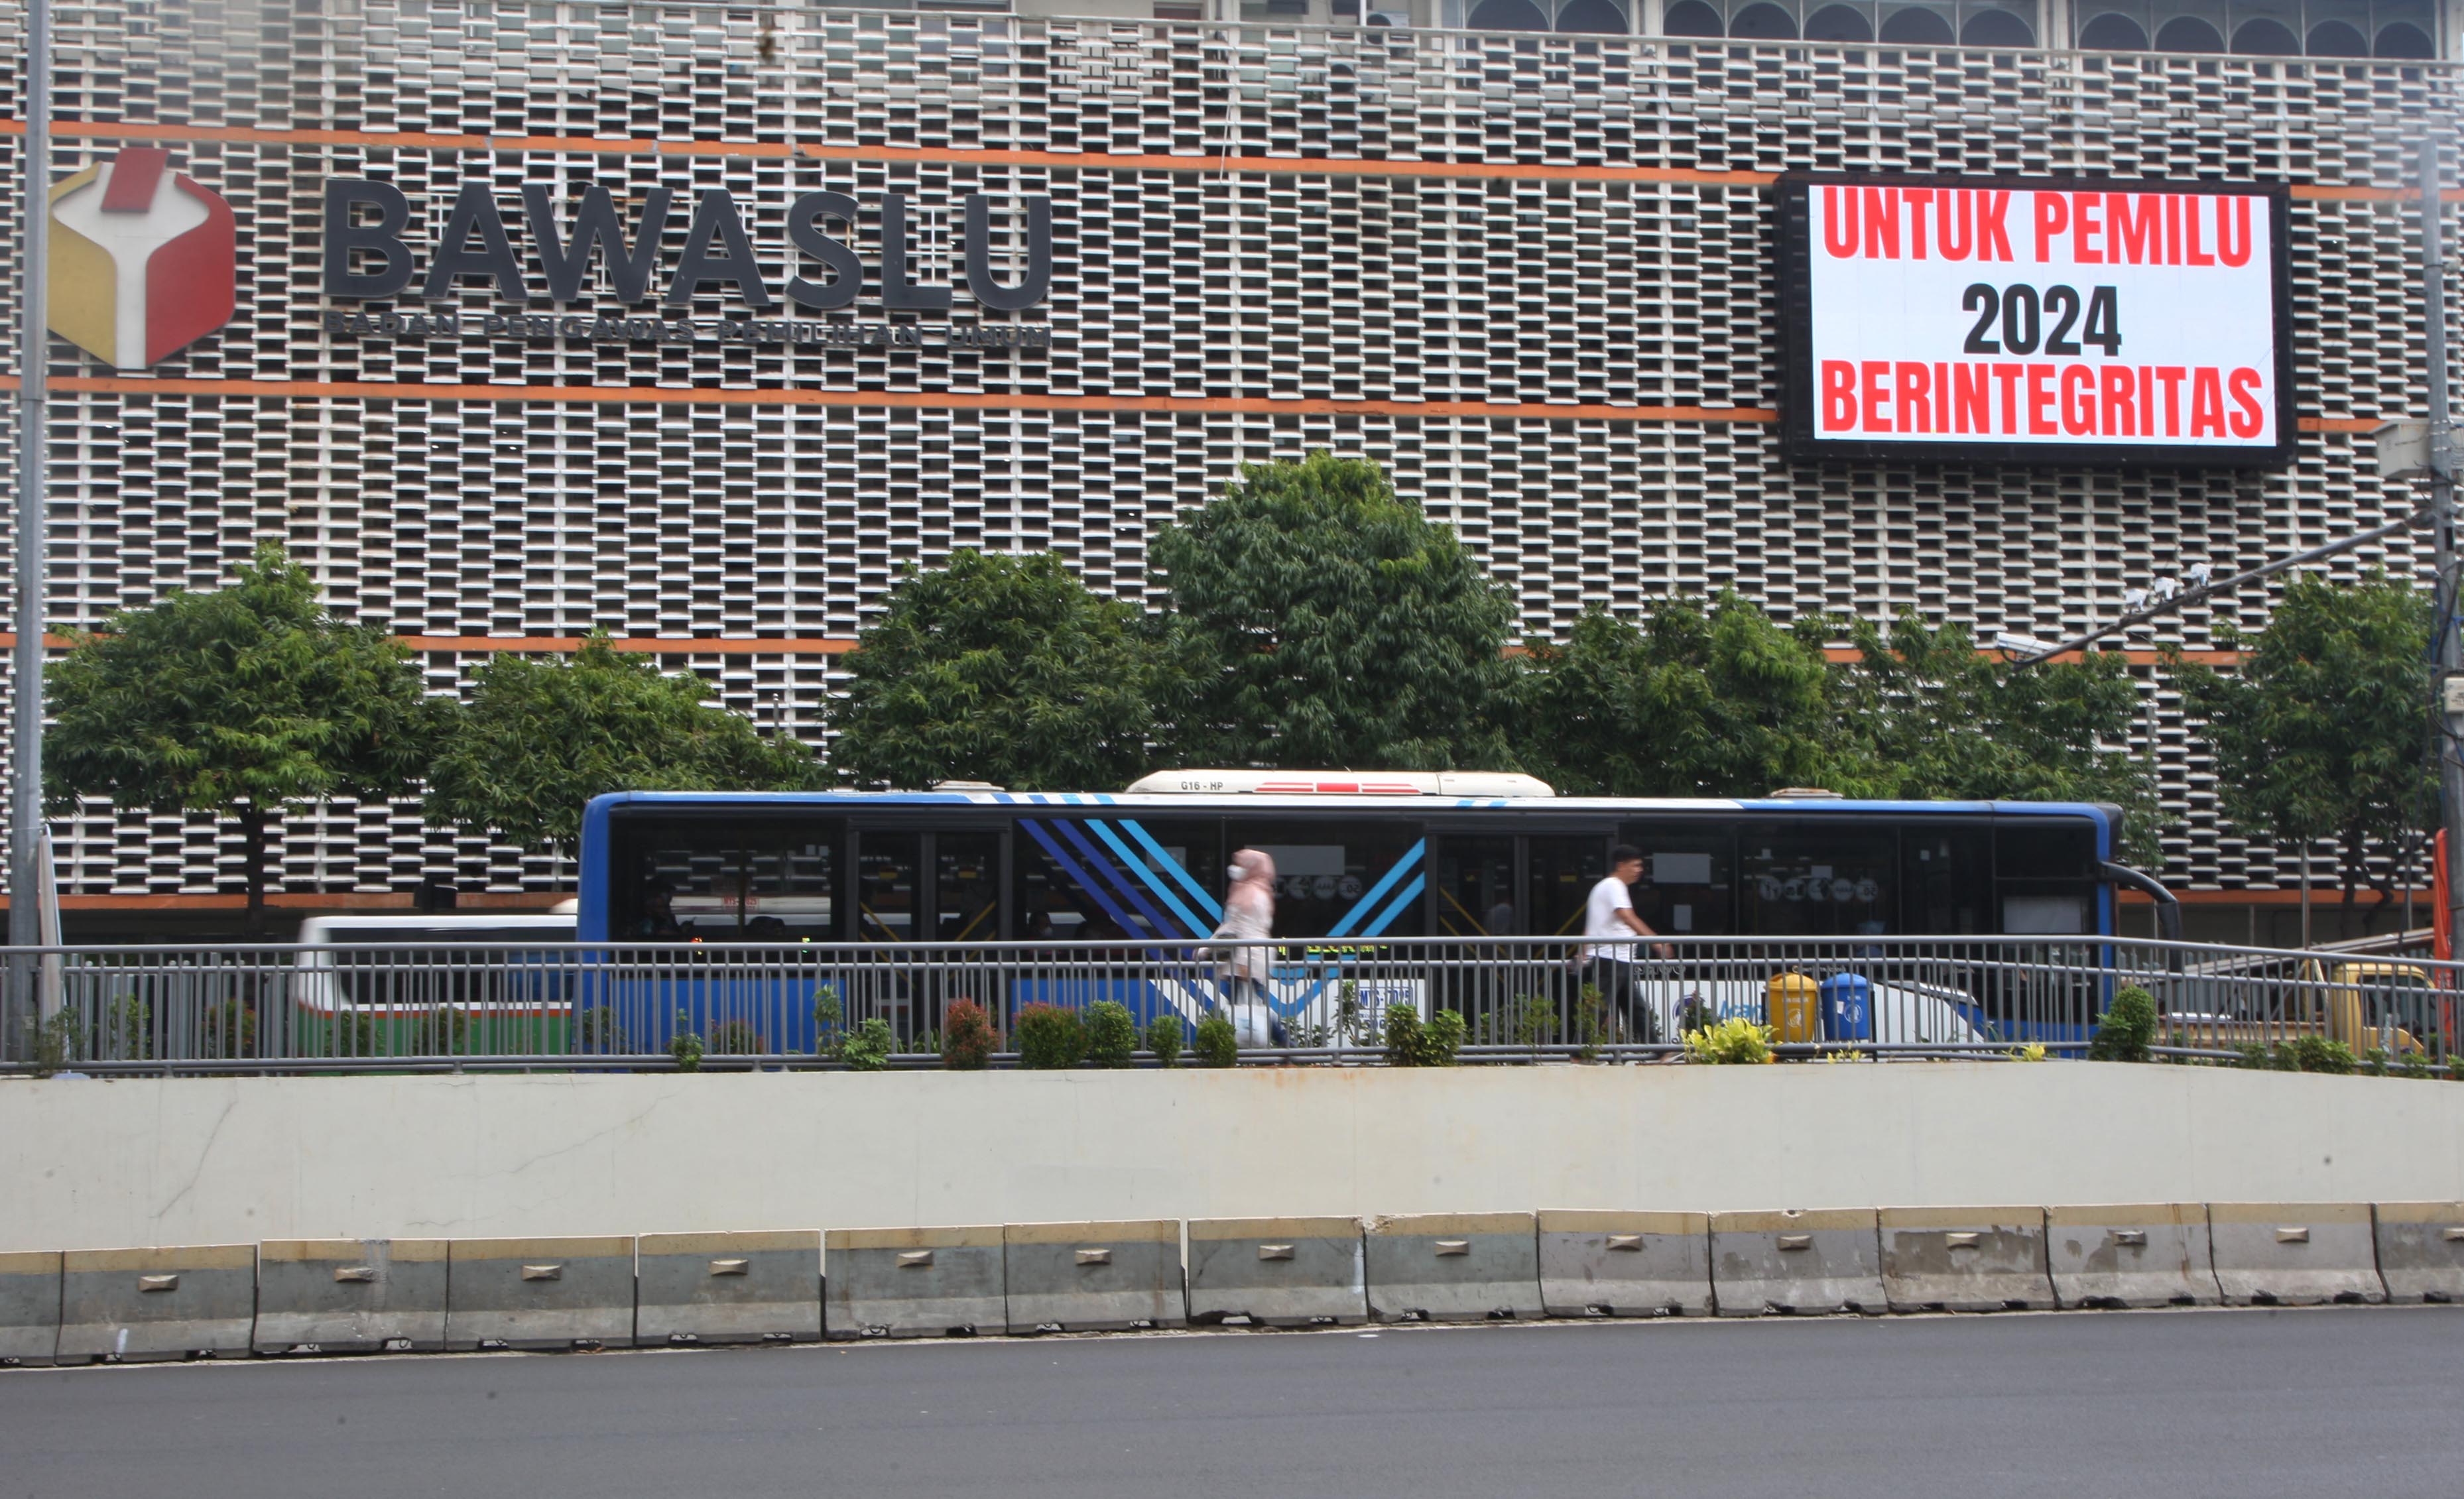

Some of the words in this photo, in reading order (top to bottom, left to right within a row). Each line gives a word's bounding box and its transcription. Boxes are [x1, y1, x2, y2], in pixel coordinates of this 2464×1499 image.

[324, 178, 1052, 311] BAWASLU
[1823, 186, 2014, 263] UNTUK
[2034, 190, 2252, 268] PEMILU
[322, 311, 459, 335] BADAN
[483, 314, 696, 341] PENGAWAS
[717, 320, 924, 347] PEMILIHAN
[946, 325, 1052, 349] UMUM
[1962, 283, 2122, 357] 2024
[1821, 360, 2264, 440] BERINTEGRITAS
[1181, 781, 1200, 790] G16
[1209, 781, 1223, 791] HP
